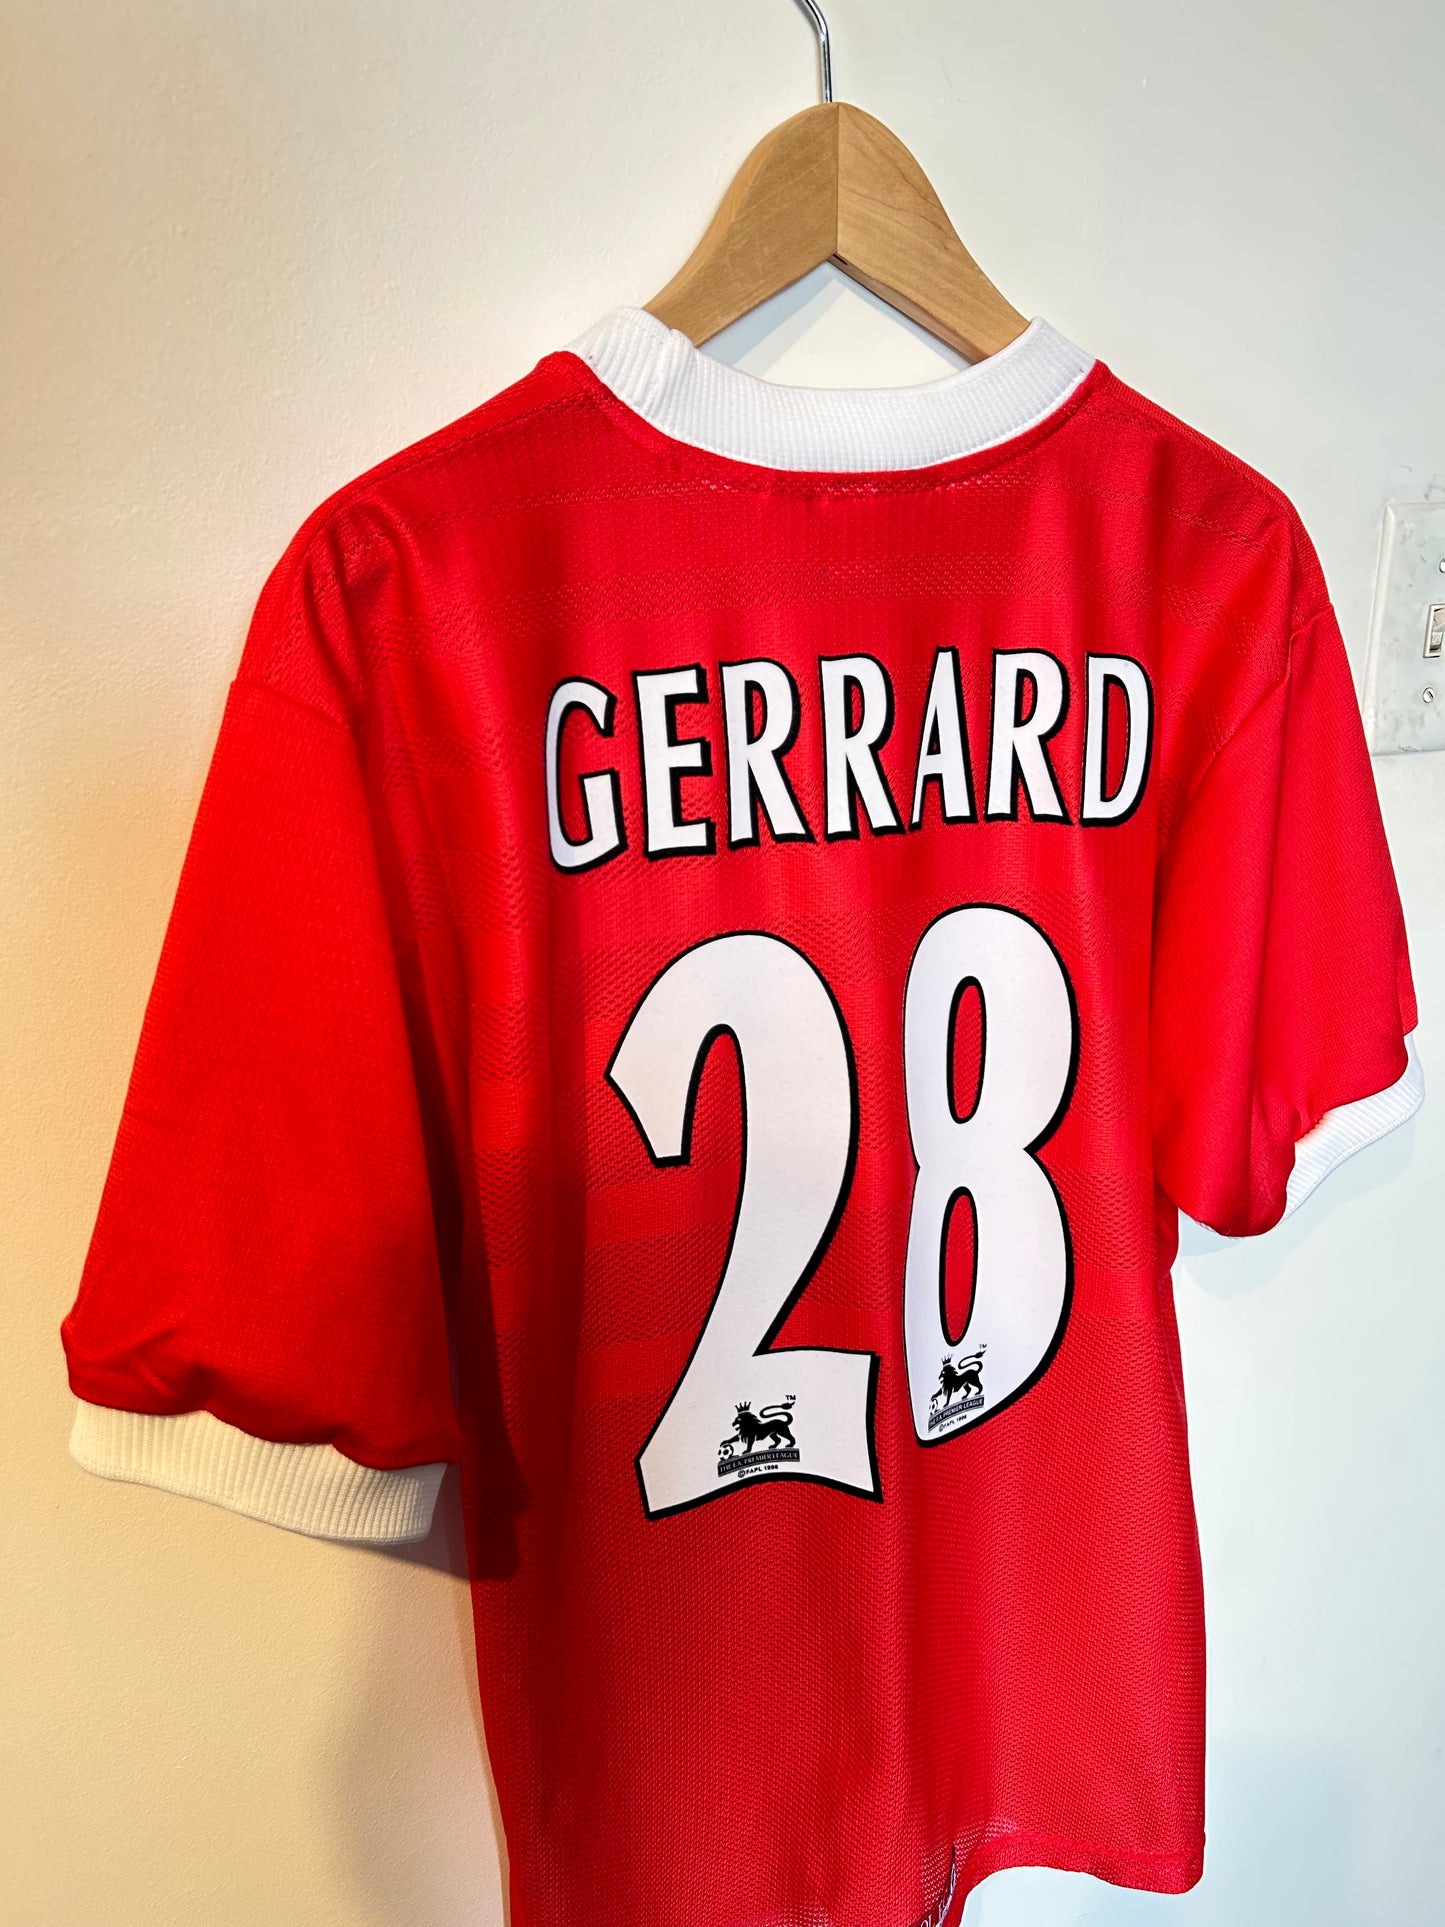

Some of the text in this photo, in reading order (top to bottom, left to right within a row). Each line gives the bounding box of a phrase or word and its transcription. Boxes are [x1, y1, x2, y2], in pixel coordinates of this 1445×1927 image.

[545, 648, 1153, 873] GERRARD
[606, 904, 1078, 1519] 28
[719, 1464, 731, 1473] THE
[744, 1454, 772, 1464] PREMIER
[943, 1405, 962, 1418] PREMIER
[963, 1398, 983, 1409] LEAGUE
